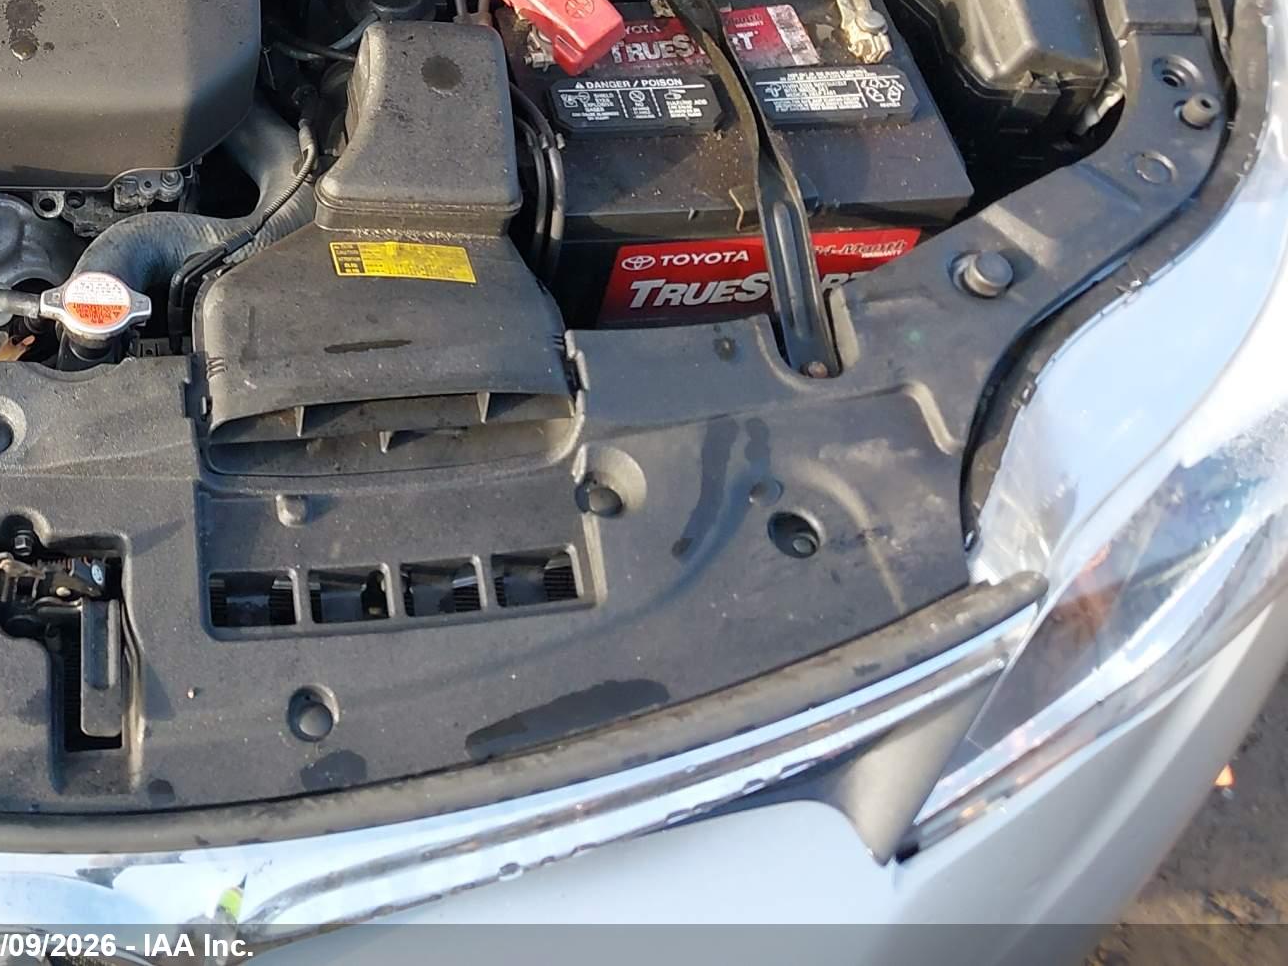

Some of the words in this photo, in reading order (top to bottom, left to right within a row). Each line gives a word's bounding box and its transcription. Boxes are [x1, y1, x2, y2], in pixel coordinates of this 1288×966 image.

[586, 80, 629, 89] DANGER
[641, 78, 682, 87] POISON
[661, 251, 749, 266] TOYOTA
